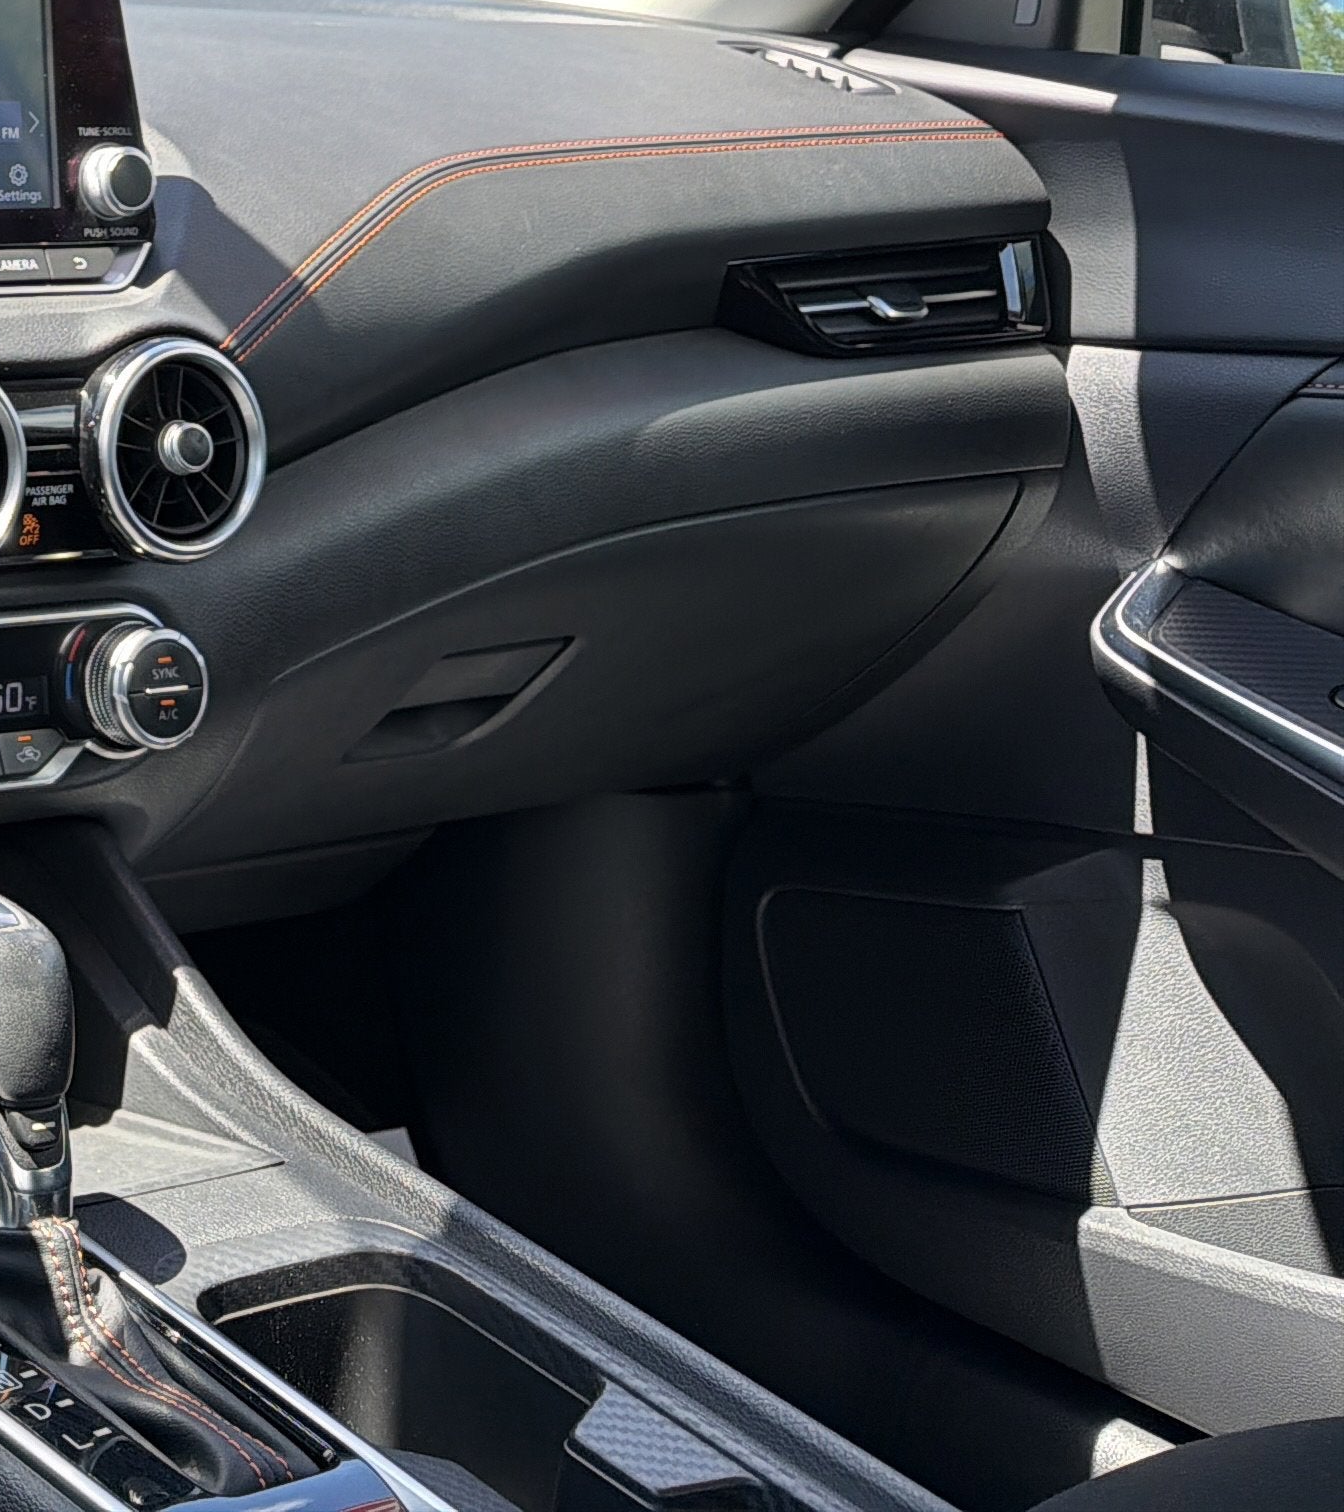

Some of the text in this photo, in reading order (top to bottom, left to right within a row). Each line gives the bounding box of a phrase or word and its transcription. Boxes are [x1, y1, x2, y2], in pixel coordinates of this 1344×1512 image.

[2, 126, 20, 139] FM
[25, 483, 74, 497] PASSENGER
[31, 495, 67, 507] AIR BAG
[18, 535, 40, 546] OFF
[151, 666, 180, 680] SYNC
[158, 708, 179, 721] A/C
[23, 1402, 52, 1421] D
[62, 1433, 95, 1450] L
